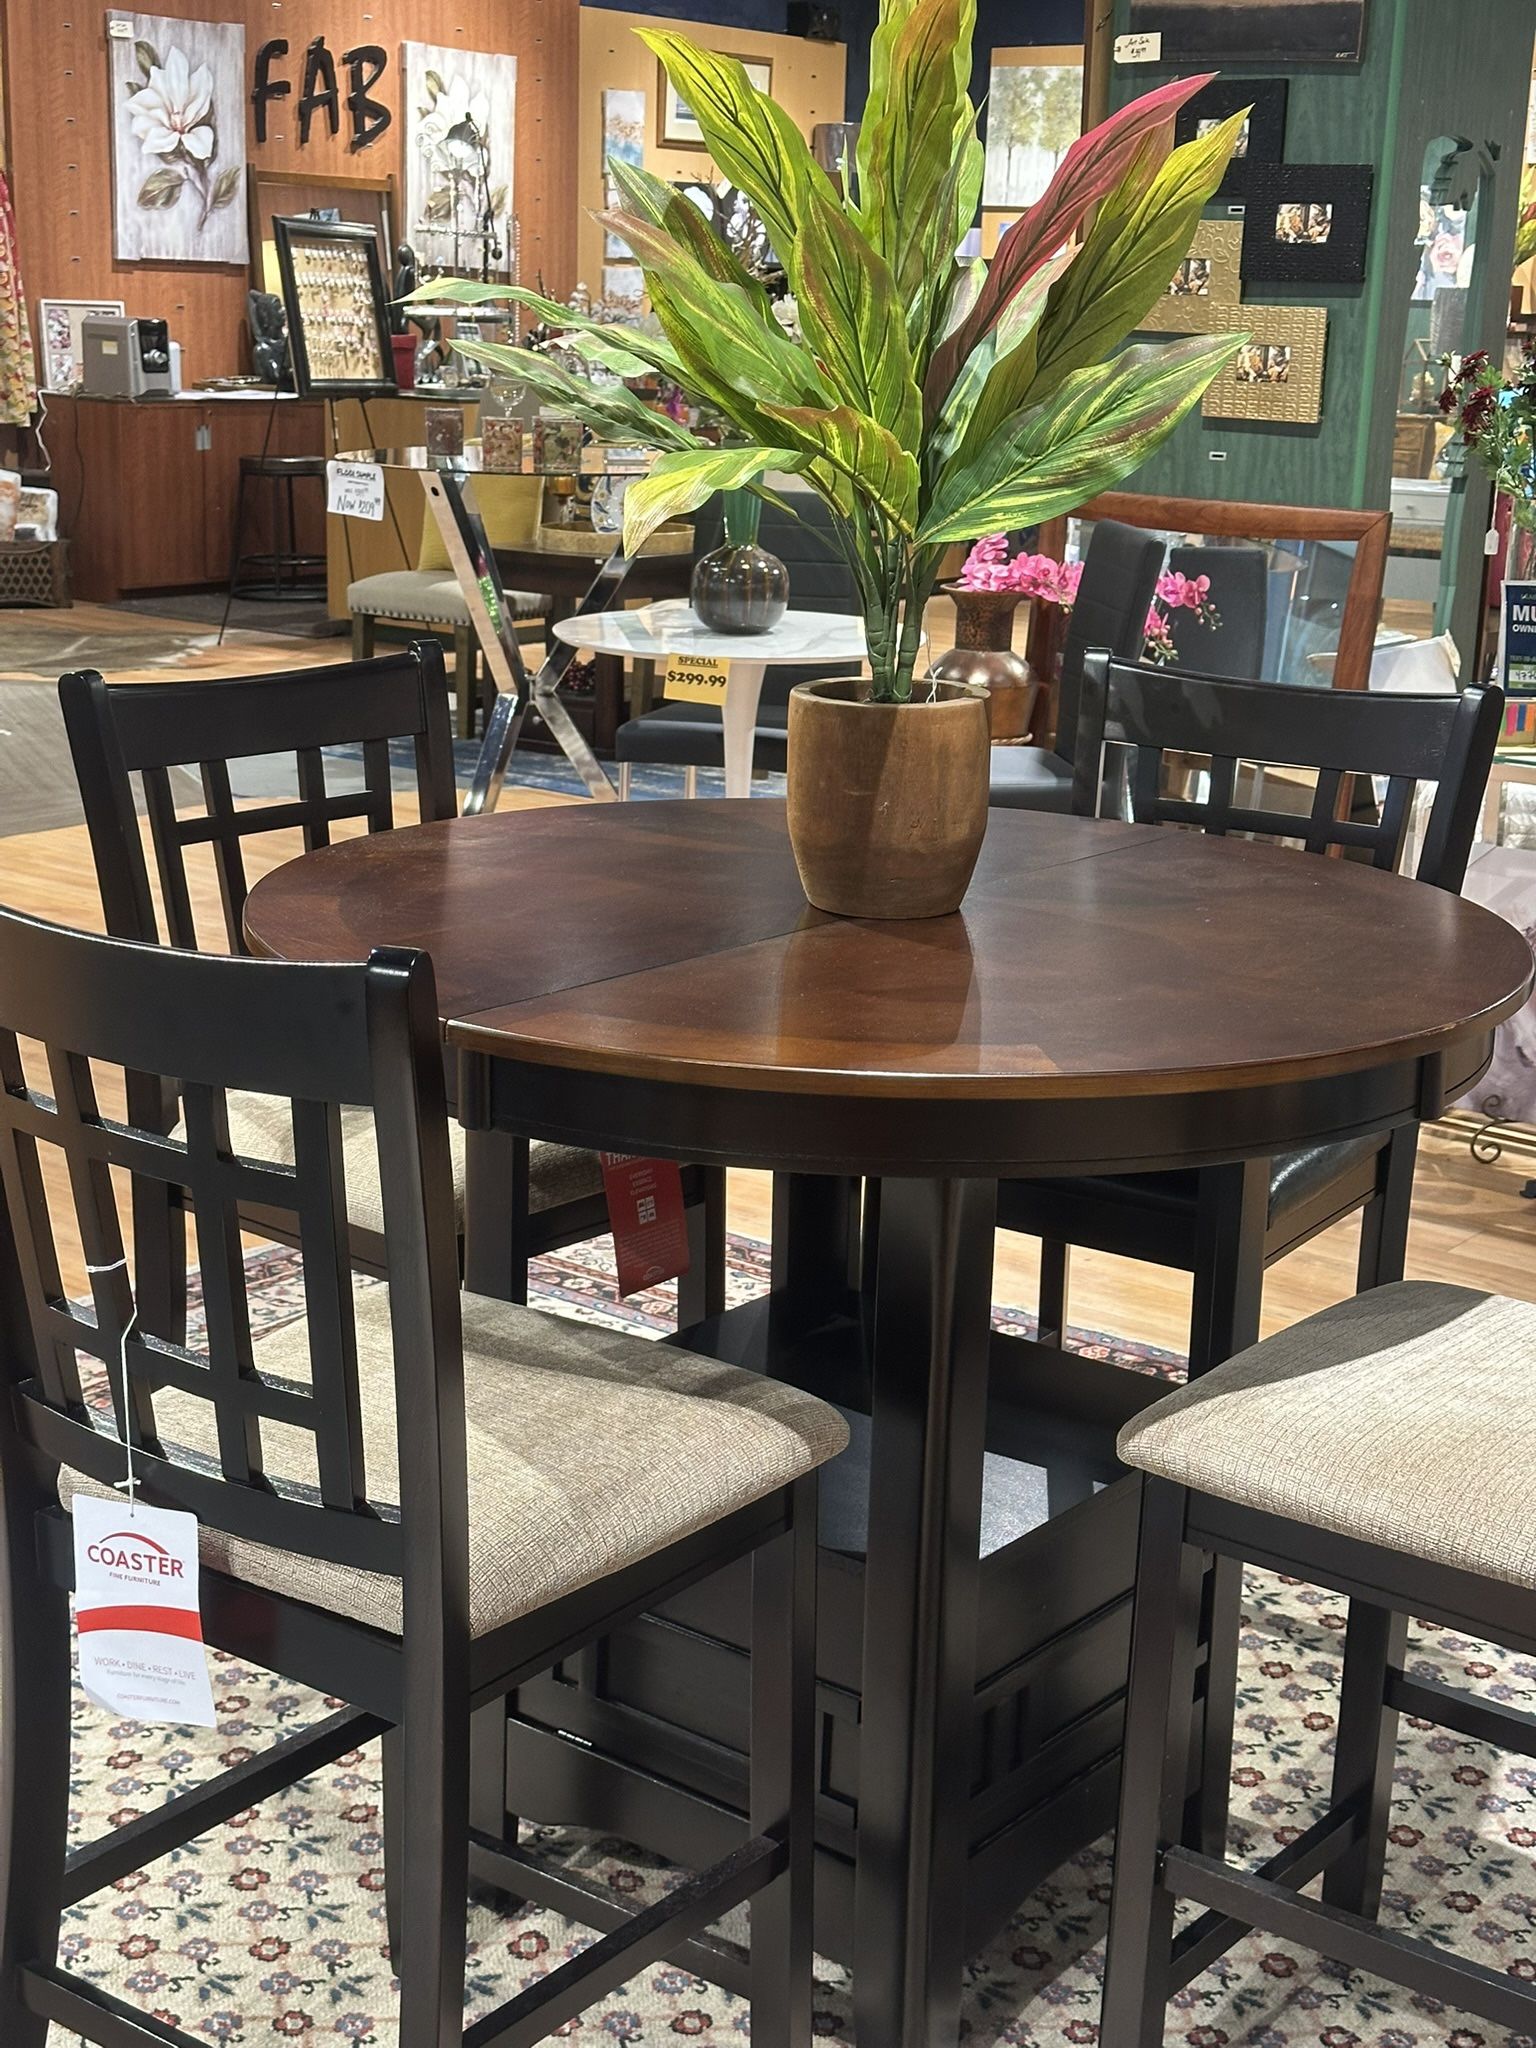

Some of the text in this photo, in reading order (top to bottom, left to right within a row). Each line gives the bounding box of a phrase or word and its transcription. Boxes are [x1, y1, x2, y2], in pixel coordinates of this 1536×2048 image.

[251, 35, 392, 155] FAB
[678, 656, 719, 668] SPECIAL
[667, 670, 727, 688] $299.99
[87, 1544, 184, 1579] COASTER
[109, 1571, 161, 1587] FINE FURNITURE
[94, 1656, 196, 1680] WORK DINE REST LIVE
